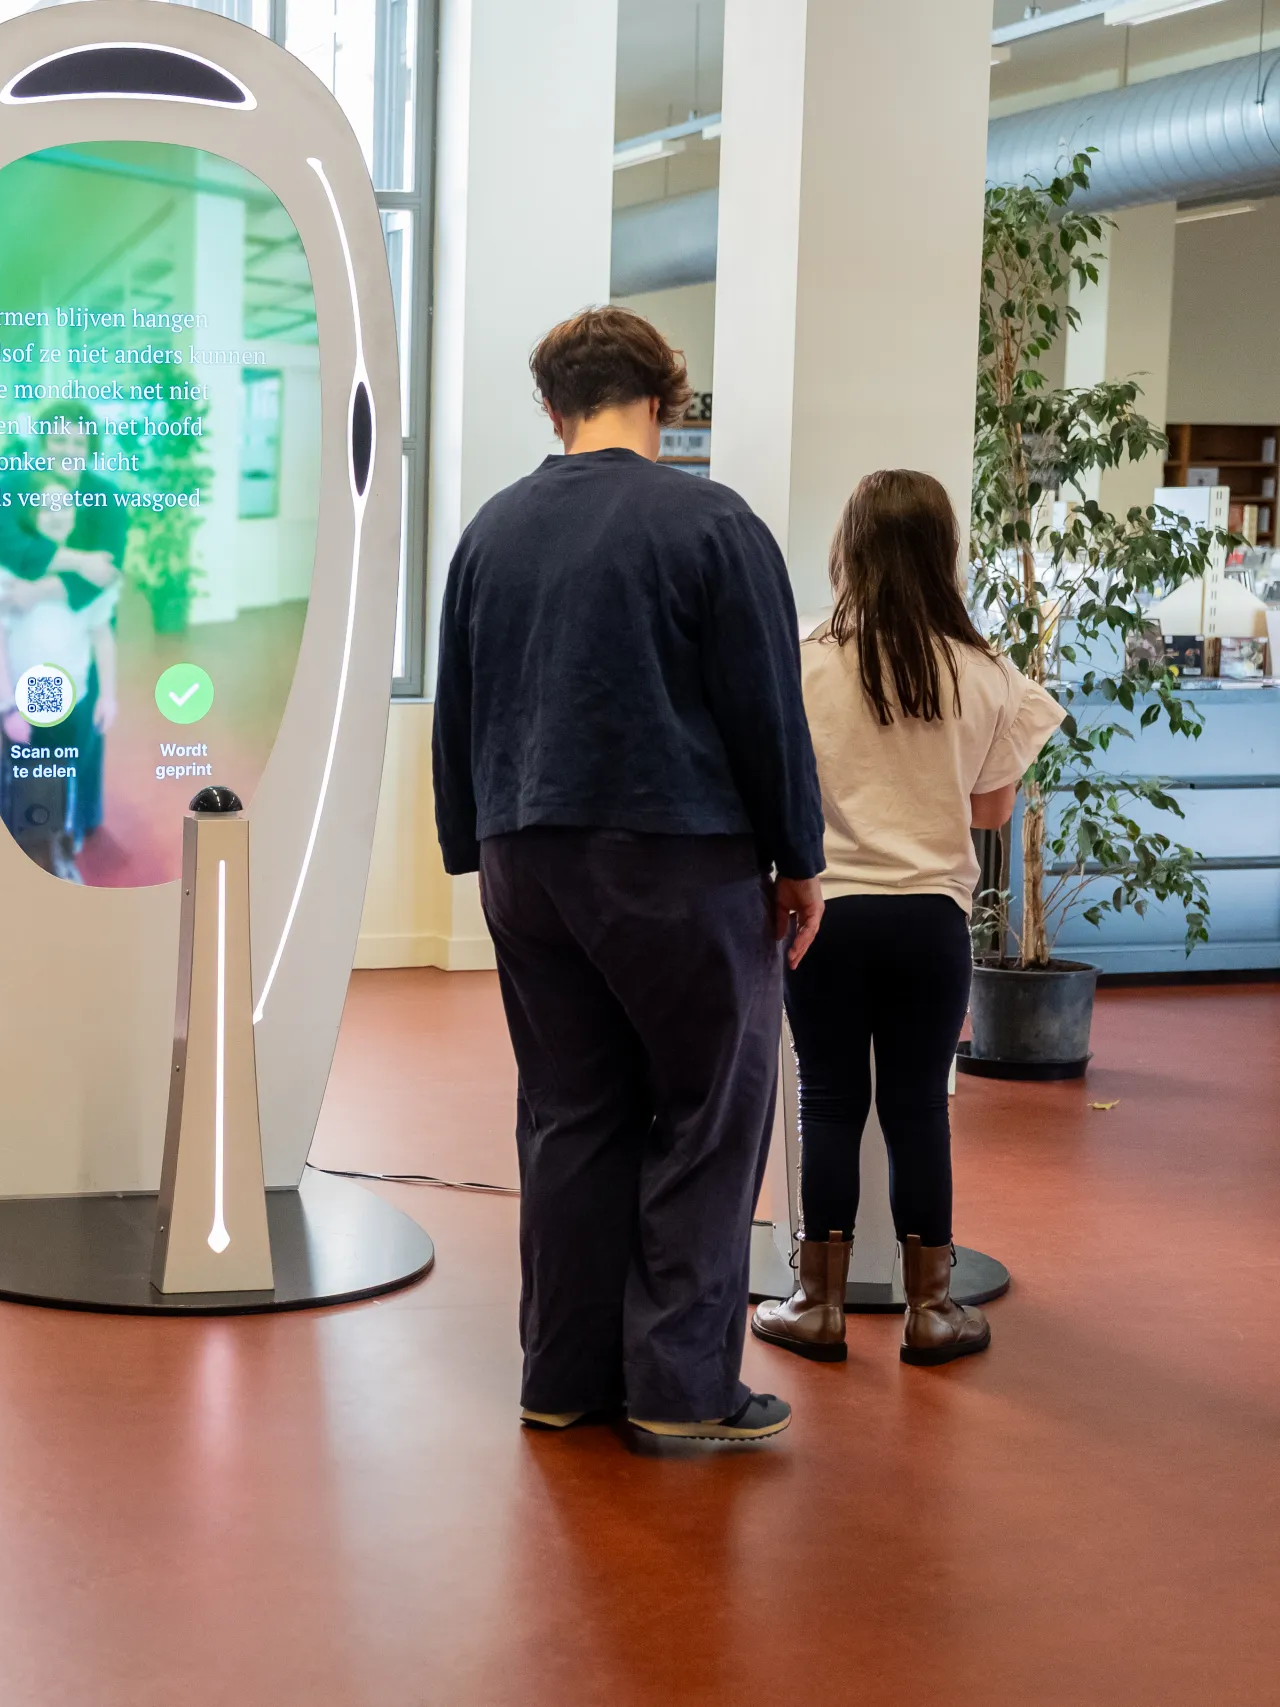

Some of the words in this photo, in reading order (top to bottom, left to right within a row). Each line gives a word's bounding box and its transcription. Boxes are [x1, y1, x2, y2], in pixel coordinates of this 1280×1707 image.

[56, 307, 126, 332] blijven
[132, 308, 209, 333] hangen
[39, 348, 61, 363] ze
[67, 344, 109, 364] niet
[115, 344, 183, 364] anders
[189, 345, 267, 365] kunnen
[13, 379, 124, 400] mondhoek
[130, 383, 163, 400] net
[169, 381, 210, 401] niet
[27, 415, 72, 435] knik
[77, 416, 99, 435] in
[104, 416, 138, 436] het
[144, 416, 204, 436] hoofd
[61, 457, 87, 471] en
[93, 452, 140, 472] licht
[18, 491, 108, 512] vergeten
[114, 488, 201, 512] wasgoed
[10, 745, 51, 759] Scan
[54, 746, 79, 759] om
[160, 743, 208, 757] Wordt
[13, 765, 29, 778] te
[32, 764, 77, 778] delen
[155, 762, 212, 780] geprint
